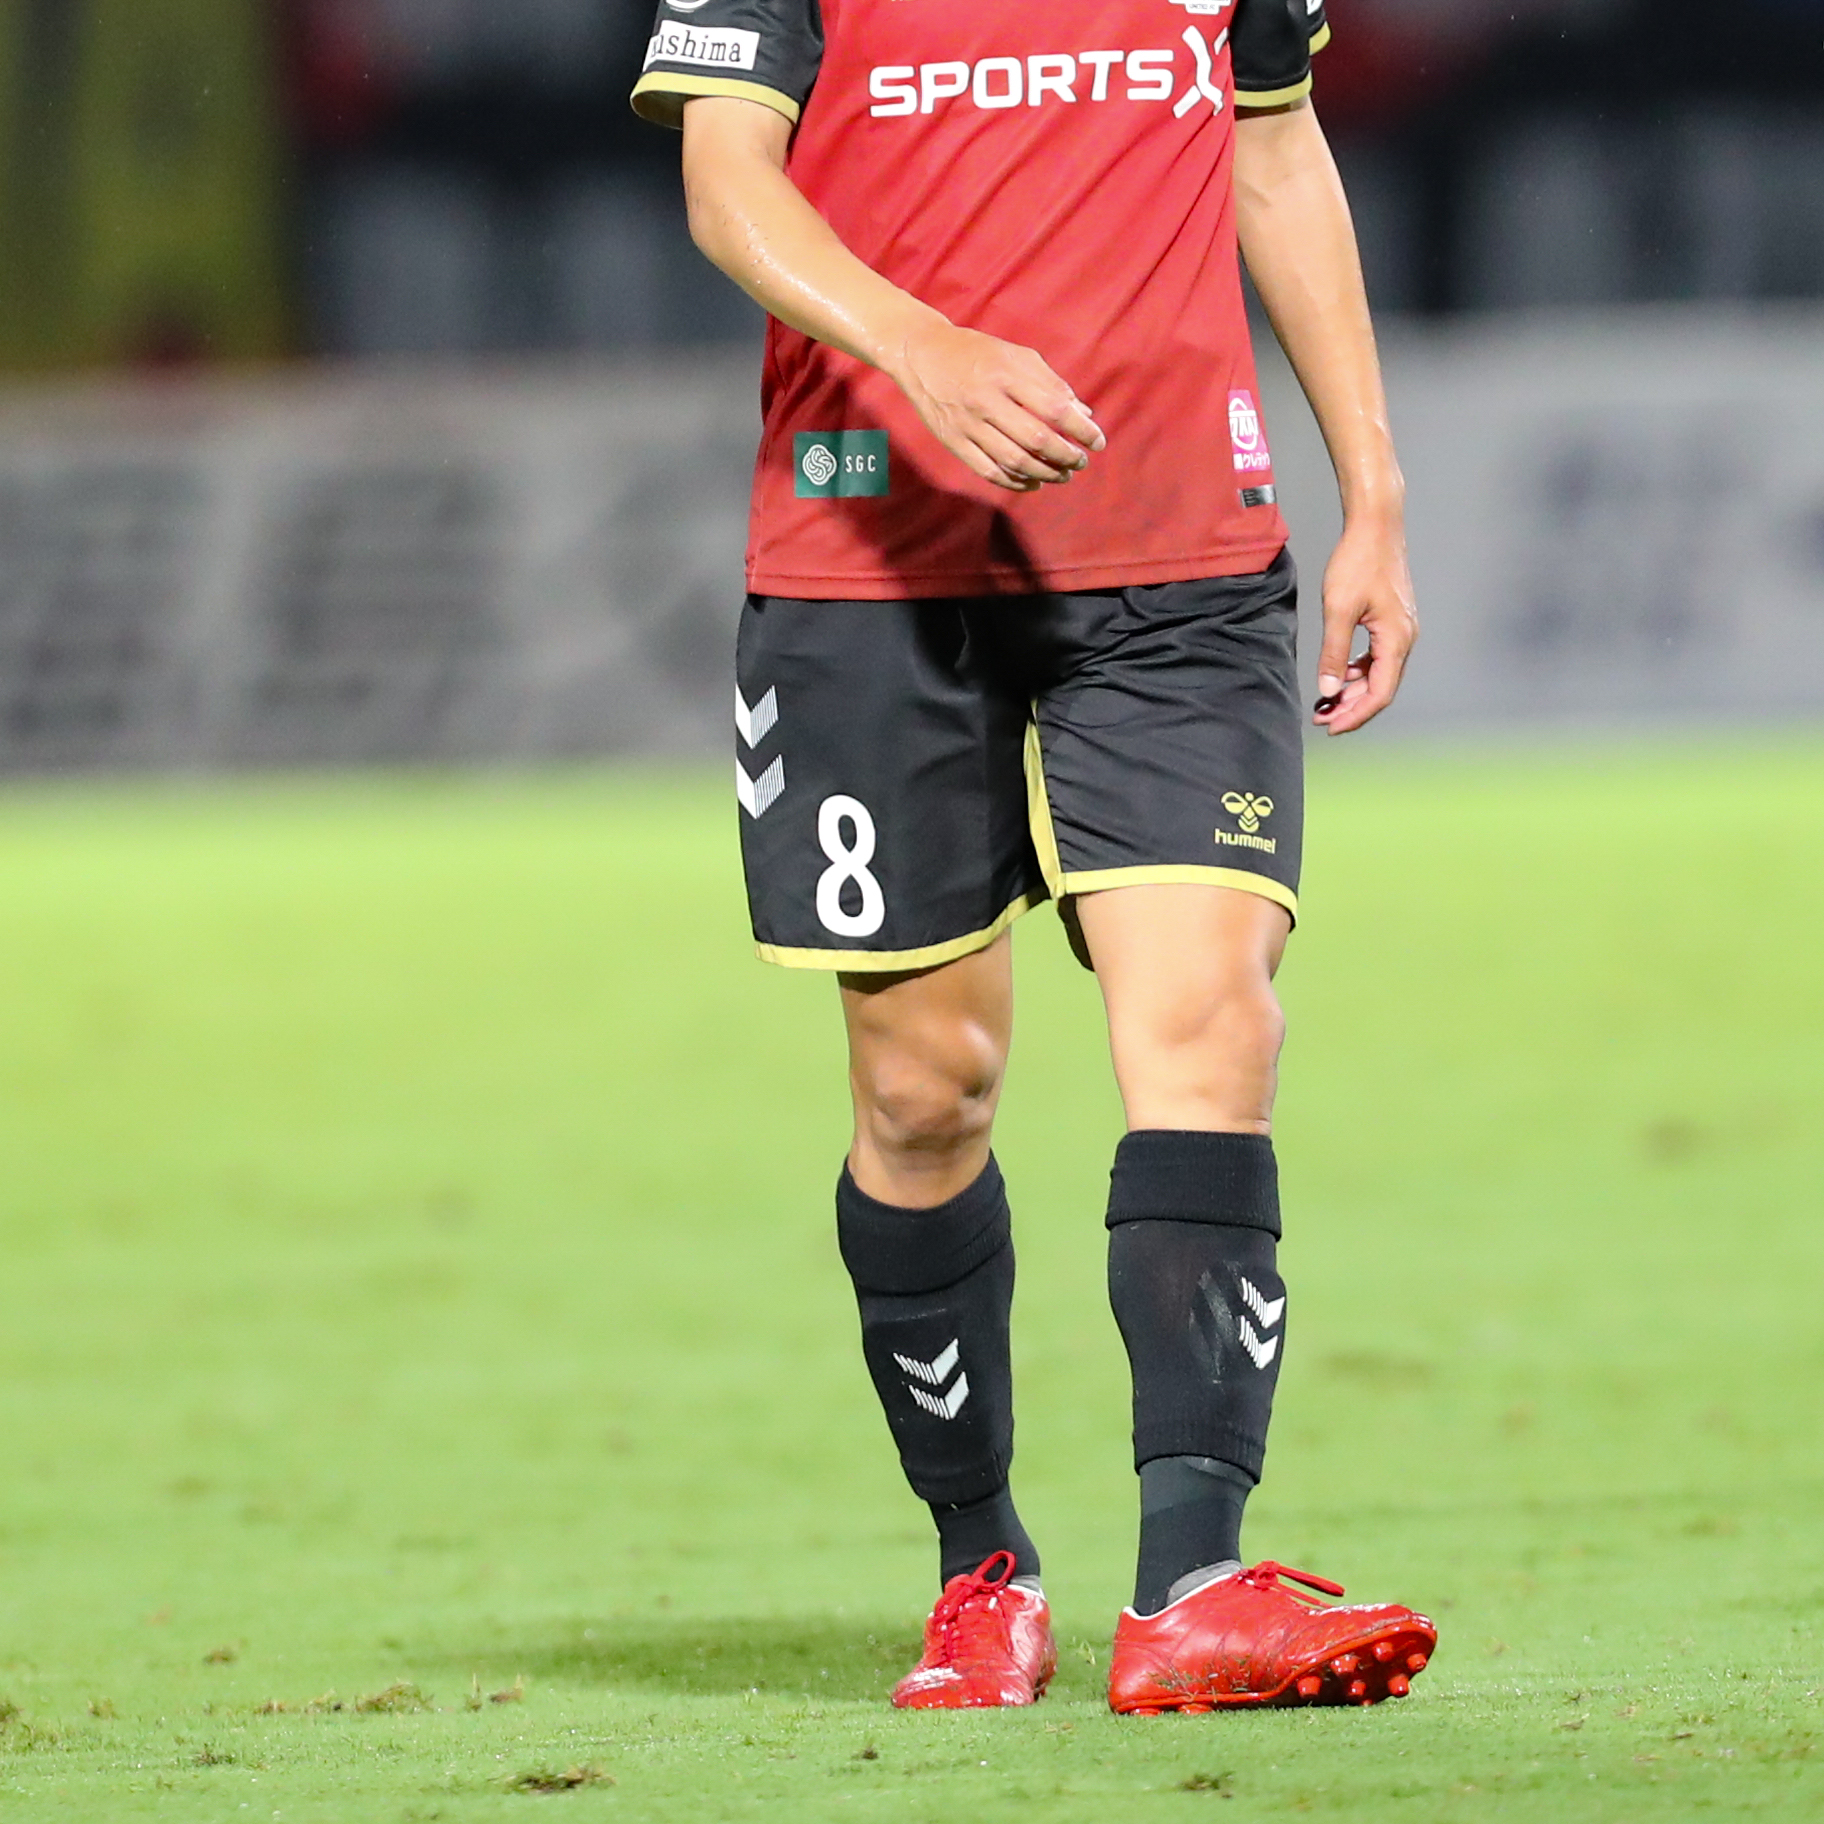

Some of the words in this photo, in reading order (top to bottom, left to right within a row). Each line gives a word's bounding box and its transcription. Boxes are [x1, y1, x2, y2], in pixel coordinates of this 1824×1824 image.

[845, 454, 876, 473] SGC
[1214, 827, 1276, 854] hummel
[816, 794, 885, 937] 8
